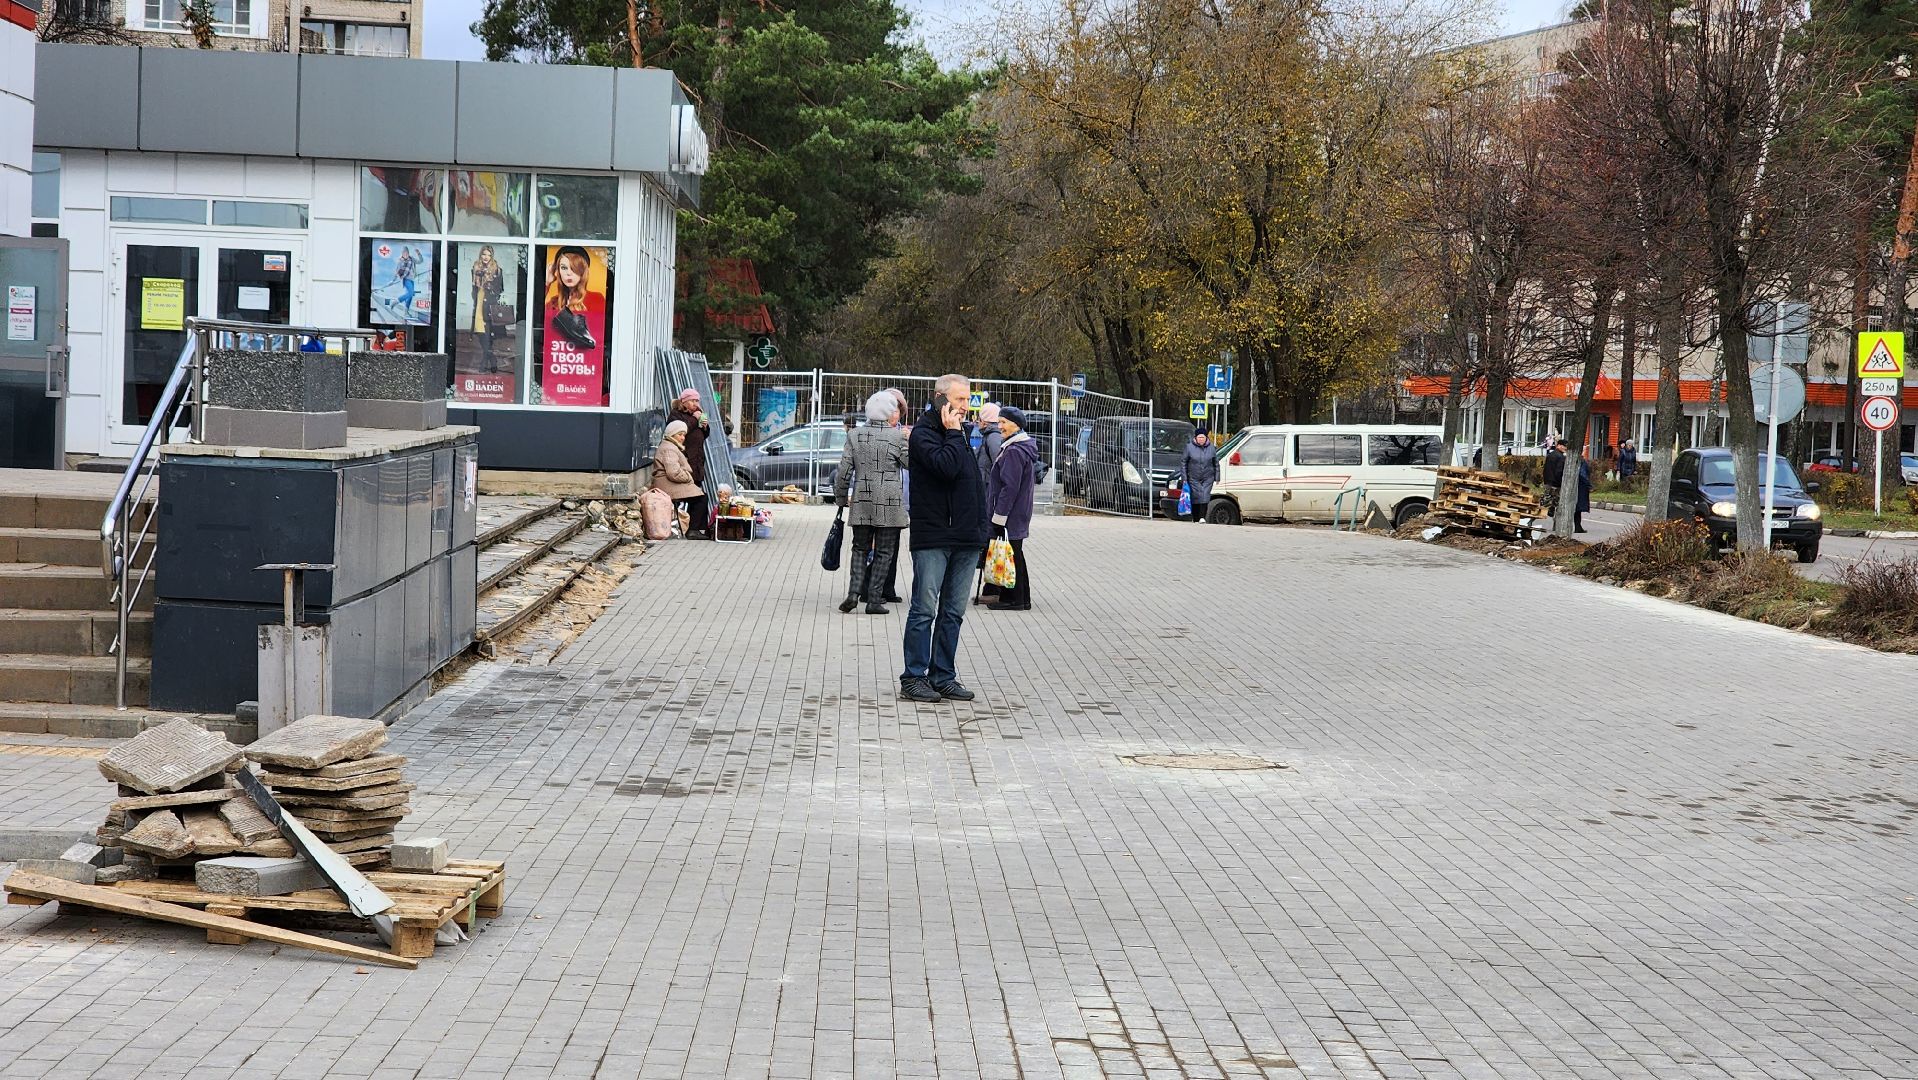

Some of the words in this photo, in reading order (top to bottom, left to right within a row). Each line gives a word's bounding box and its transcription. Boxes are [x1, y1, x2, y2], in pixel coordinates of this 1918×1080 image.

[551, 340, 576, 352] ЭТО
[550, 351, 585, 364] ТВОЯ
[550, 363, 596, 376] ОБУВЬ!
[475, 384, 504, 392] BADEN
[1865, 382, 1885, 391] 250
[1870, 407, 1889, 420] 40
